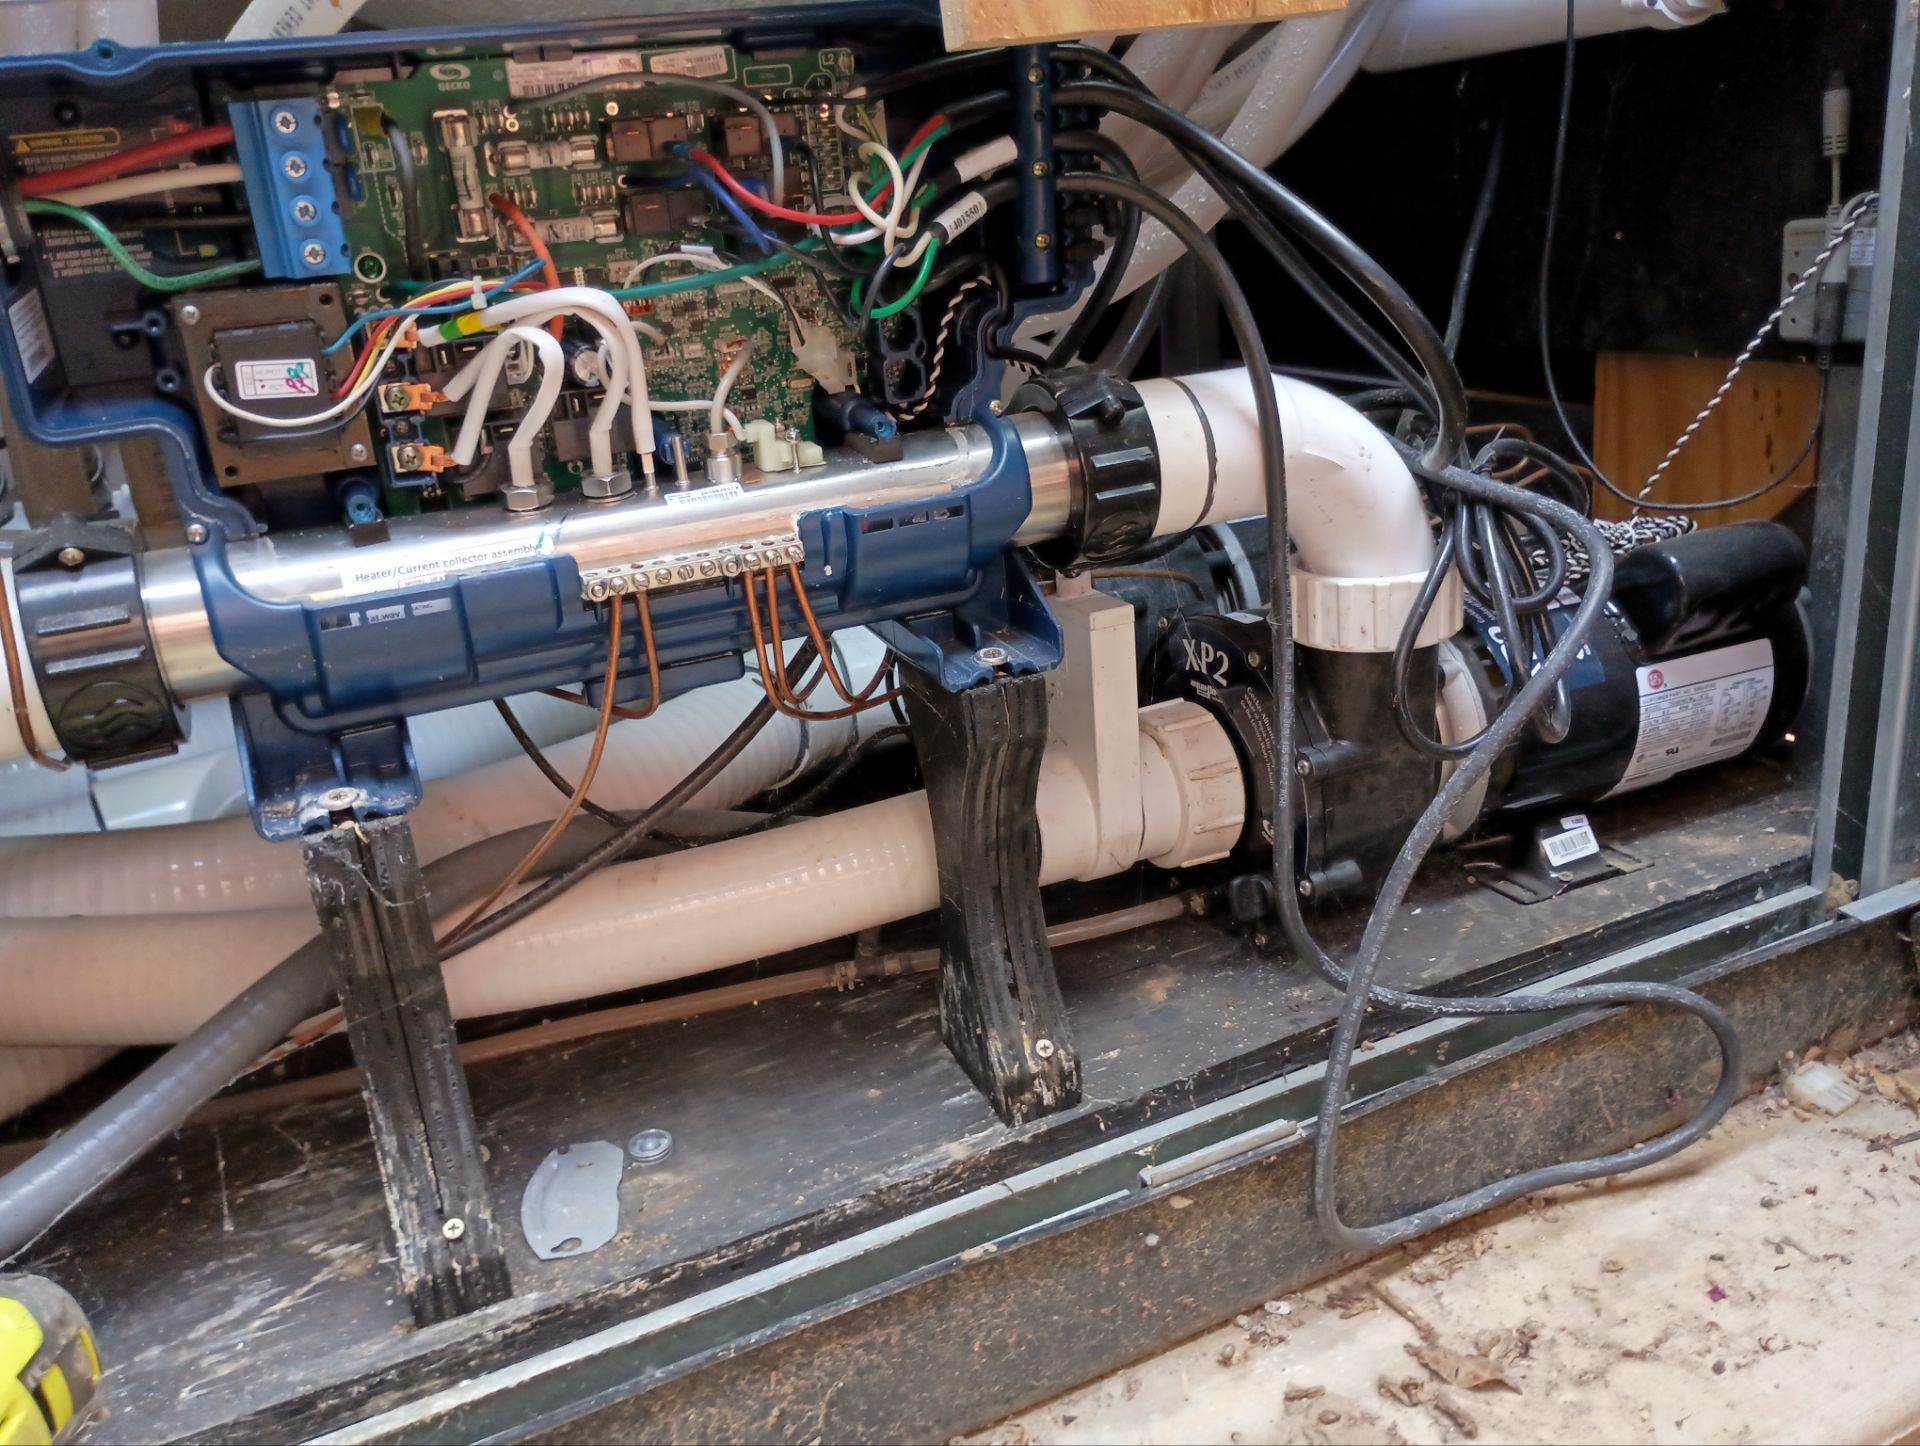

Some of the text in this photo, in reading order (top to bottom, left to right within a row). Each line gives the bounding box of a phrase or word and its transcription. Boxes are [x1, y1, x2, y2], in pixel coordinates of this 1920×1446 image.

[822, 53, 835, 65] L2
[438, 81, 471, 91] GECKO
[355, 561, 440, 582] Heater/Current
[443, 552, 488, 567] collector
[1182, 639, 1229, 687] XP2
